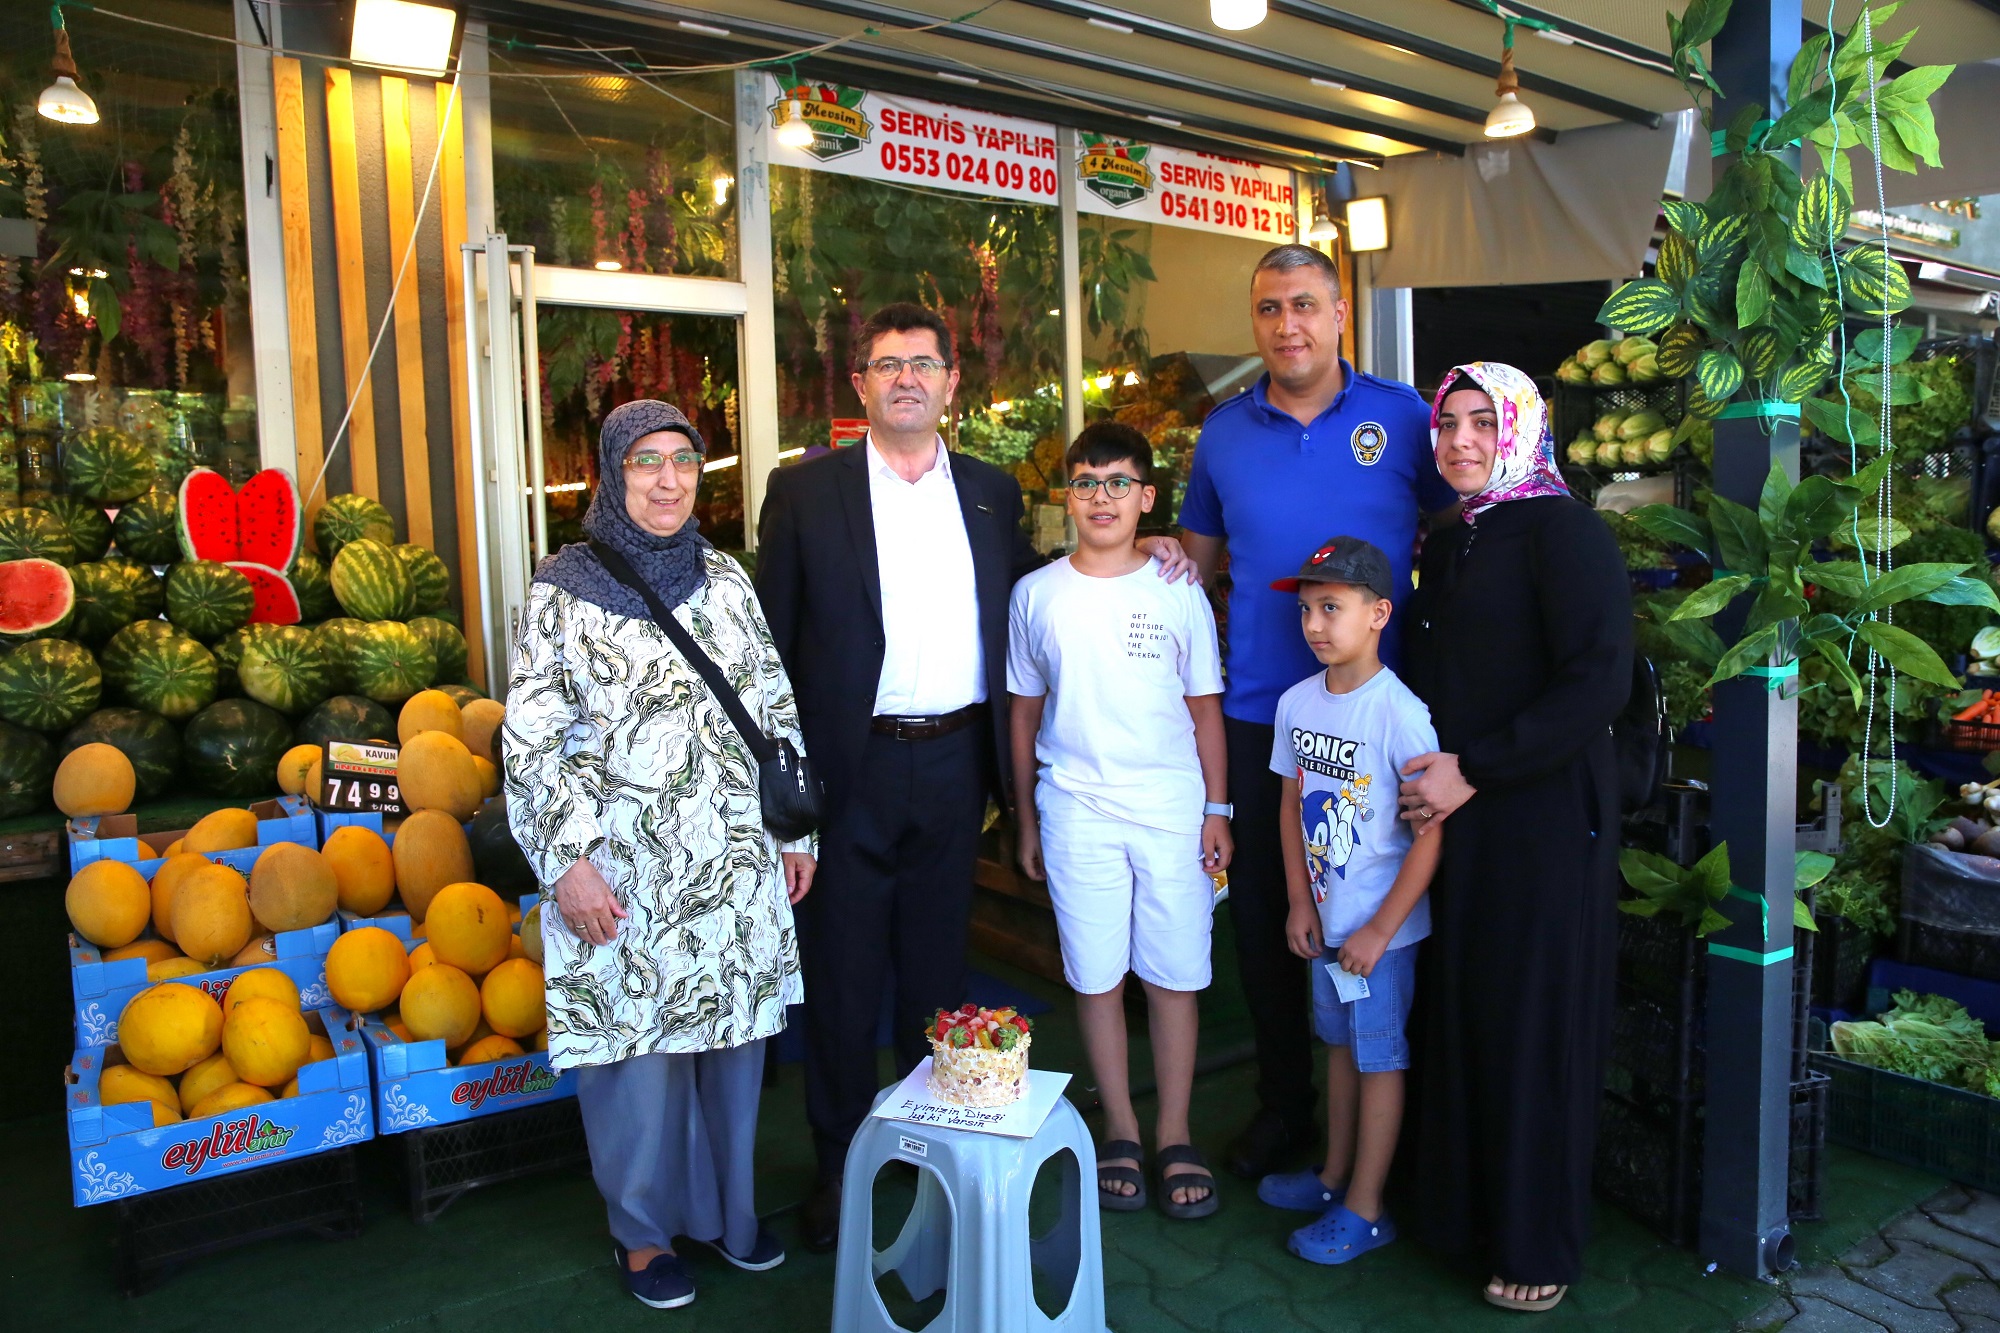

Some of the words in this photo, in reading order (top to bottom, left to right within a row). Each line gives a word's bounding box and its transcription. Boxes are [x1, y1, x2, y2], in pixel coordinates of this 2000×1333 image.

[802, 102, 857, 125] Mevsim
[813, 138, 843, 152] ganik
[880, 108, 966, 145] SERVİS
[973, 124, 1056, 161] YAPILIR
[880, 141, 941, 178] 0553
[946, 152, 990, 185] 024
[995, 160, 1024, 190] 09
[1029, 166, 1057, 196] 80
[1090, 157, 1098, 168] 4
[1101, 157, 1143, 177] Mevsim
[1160, 161, 1225, 193] SERVİS
[1230, 175, 1293, 206] YAPILIR
[1100, 186, 1132, 200] organik
[1160, 191, 1209, 222] 0541
[1213, 200, 1247, 229] 910
[1252, 207, 1271, 232] 12
[1275, 211, 1294, 236] 19
[1130, 622, 1163, 630] OUTSIDE
[365, 749, 396, 761] KAVUN
[1291, 727, 1359, 767] SONIC
[450, 1061, 532, 1110] eylül
[161, 1113, 259, 1175] eylül
